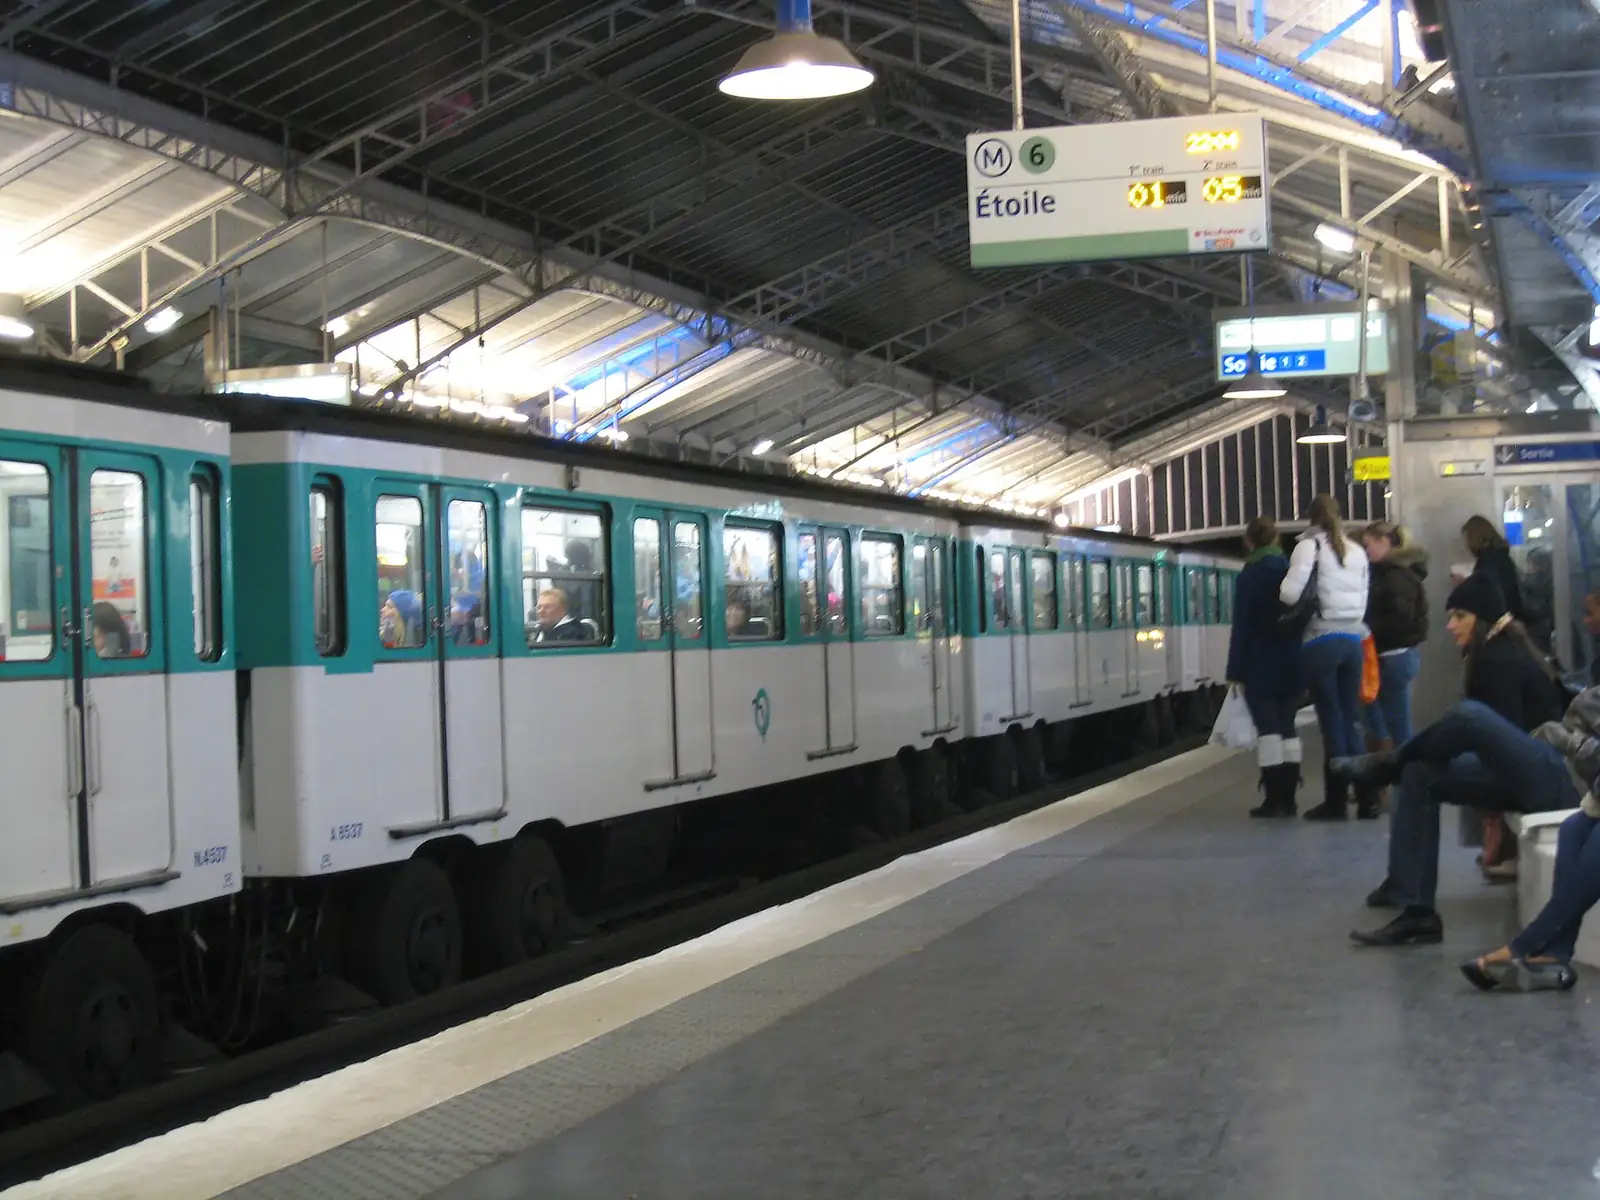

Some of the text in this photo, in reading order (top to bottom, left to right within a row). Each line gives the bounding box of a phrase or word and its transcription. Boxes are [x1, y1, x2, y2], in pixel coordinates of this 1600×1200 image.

[982, 144, 1045, 169] M 6
[976, 188, 1057, 219] Étoile
[1128, 181, 1165, 208] 01
[1202, 175, 1242, 205] 05
[1223, 353, 1278, 374] Soie
